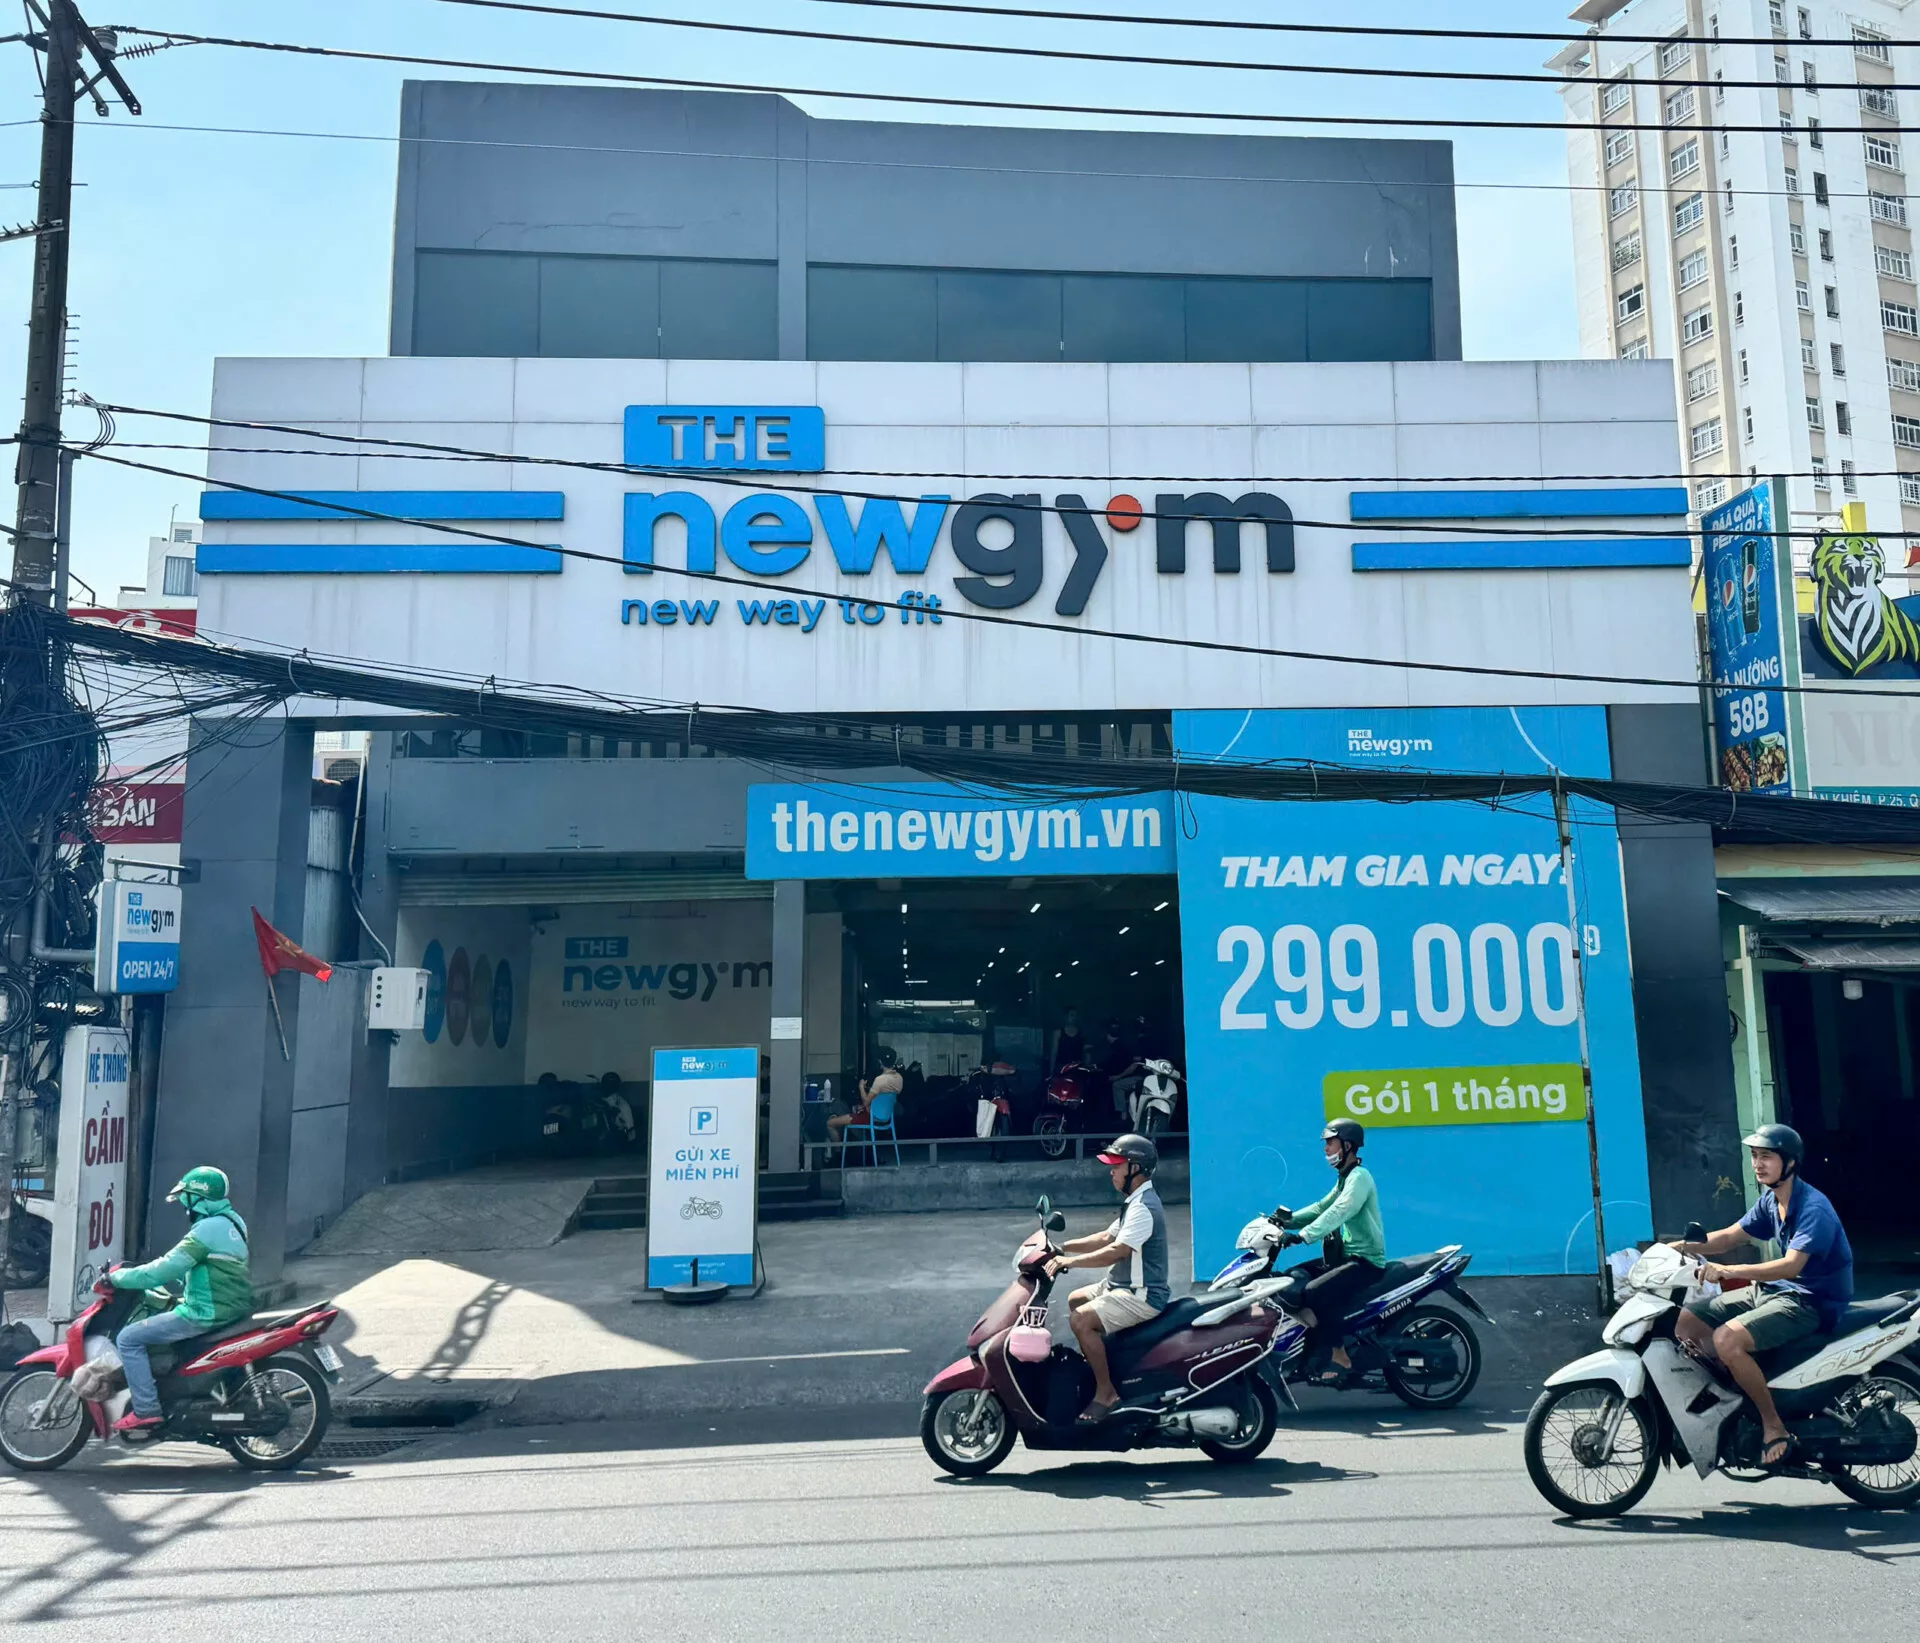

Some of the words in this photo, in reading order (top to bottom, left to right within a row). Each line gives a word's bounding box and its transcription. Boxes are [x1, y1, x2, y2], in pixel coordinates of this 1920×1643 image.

[657, 415, 792, 462] THE
[622, 491, 1296, 617] newgym
[621, 598, 720, 625] new
[736, 598, 826, 634] way
[839, 594, 885, 625] to
[897, 590, 943, 625] fit
[1729, 691, 1769, 738] 58B
[1348, 739, 1433, 756] newgym
[771, 800, 1162, 862] thenewgym.vn
[1219, 855, 1346, 888] THAM
[1355, 854, 1429, 887] GIA
[127, 908, 175, 933] newgym
[574, 940, 619, 956] THE
[122, 960, 151, 979] OPEN
[153, 957, 175, 980] 24/7
[562, 961, 773, 1002] newgym
[1216, 921, 1579, 1030] 299.000
[1344, 1081, 1412, 1116] Gói
[1423, 1082, 1440, 1112] 1
[1452, 1078, 1567, 1114] tháng
[675, 1146, 704, 1162] GỬI
[709, 1148, 731, 1161] XE
[712, 1164, 740, 1180] PHÍ
[1379, 1297, 1412, 1321] YAMAHA
